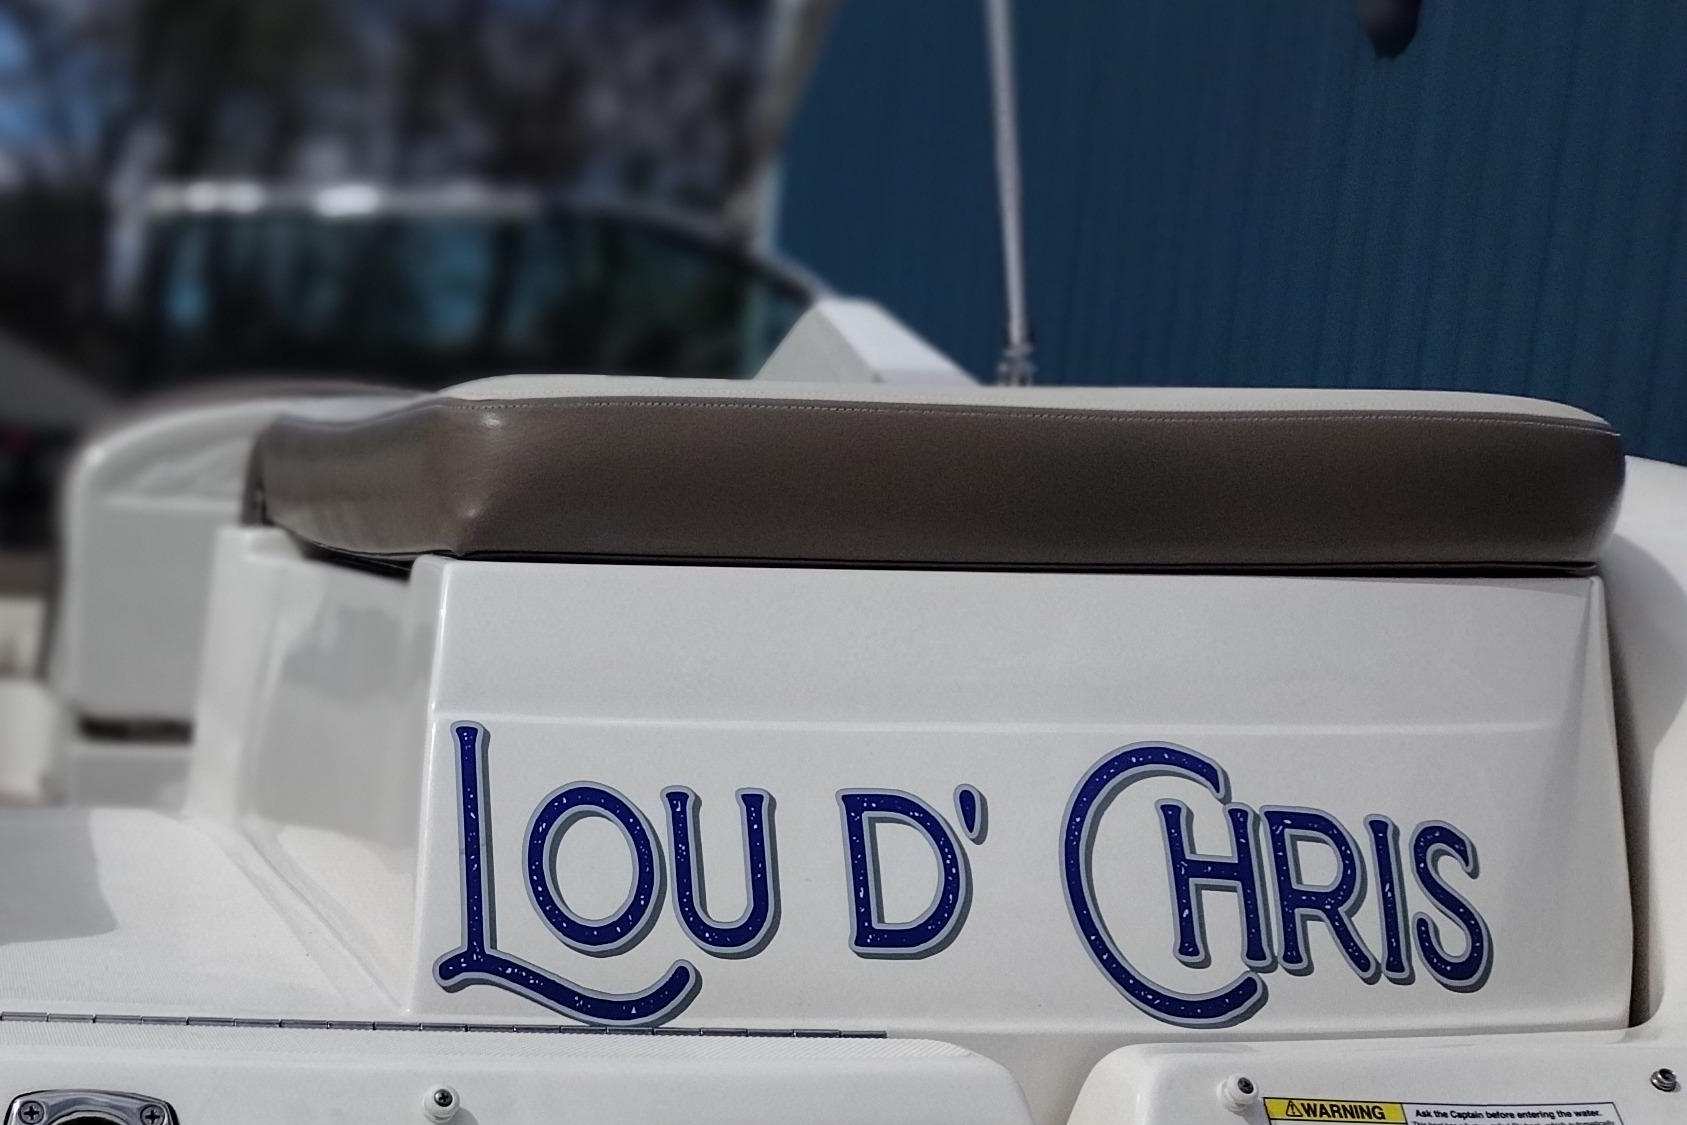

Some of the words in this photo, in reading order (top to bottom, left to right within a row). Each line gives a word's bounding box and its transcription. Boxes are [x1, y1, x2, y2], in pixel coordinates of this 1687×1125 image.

[433, 720, 782, 1028] LOU
[839, 783, 989, 959] D'
[1060, 741, 1495, 1029] CHRIS
[1303, 1102, 1387, 1121] WARNING
[1416, 1110, 1432, 1118] Ask
[1450, 1110, 1484, 1120] Captain
[1485, 1111, 1515, 1119] before
[1517, 1111, 1555, 1120] entering
[1556, 1110, 1572, 1118] the
